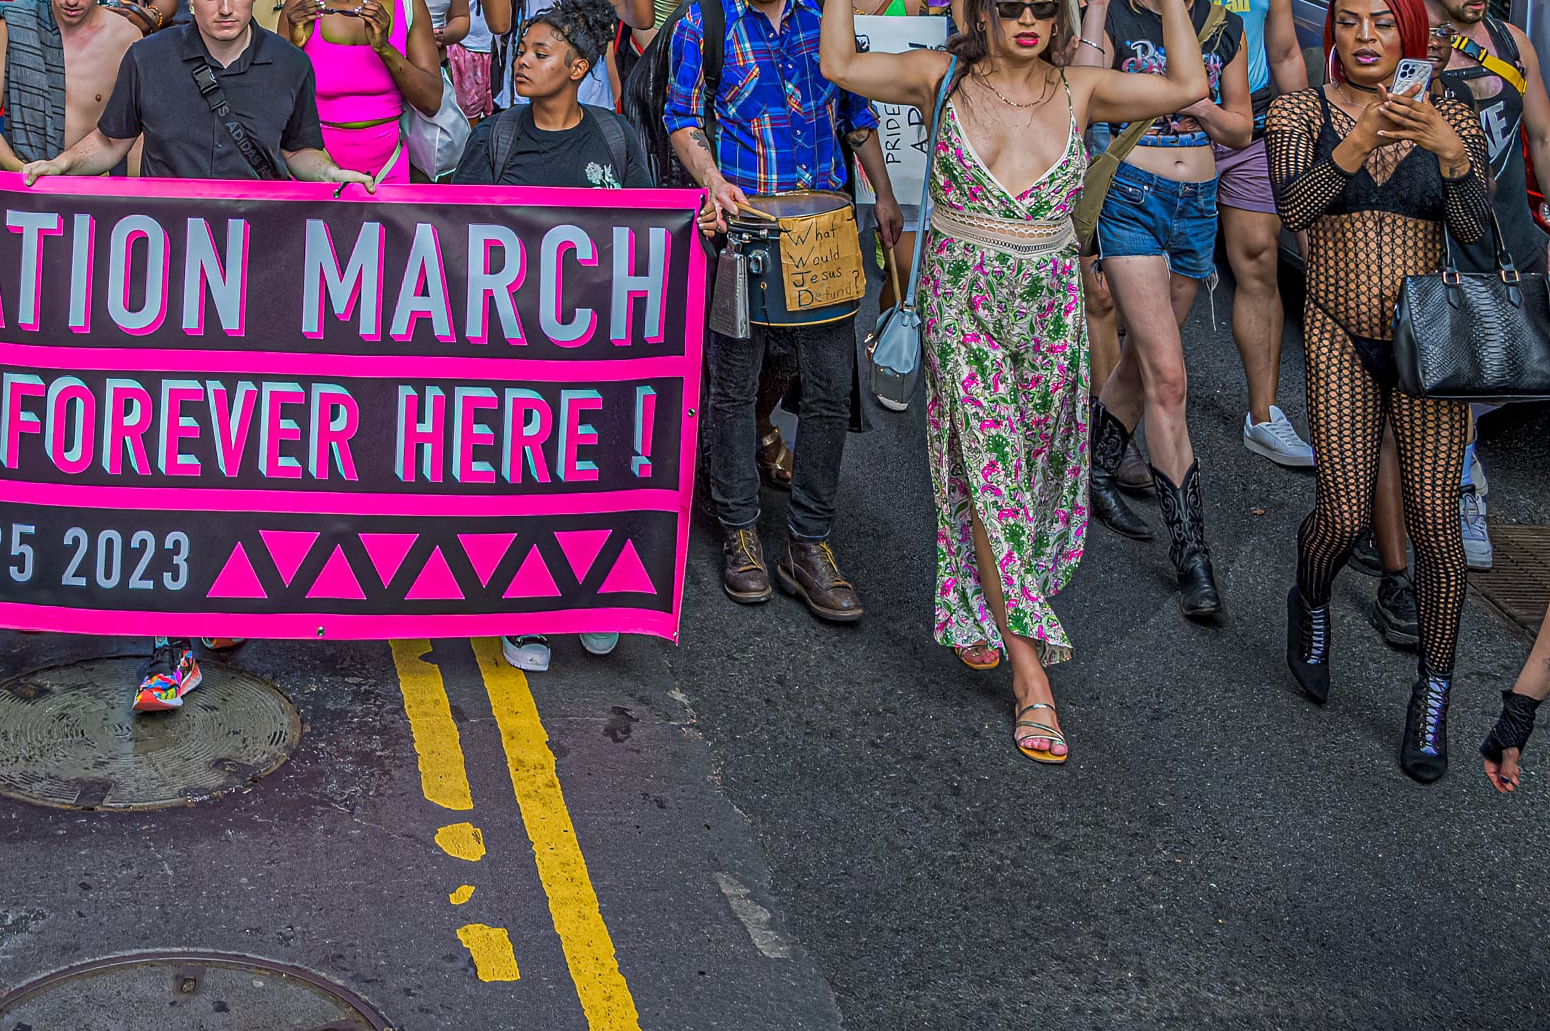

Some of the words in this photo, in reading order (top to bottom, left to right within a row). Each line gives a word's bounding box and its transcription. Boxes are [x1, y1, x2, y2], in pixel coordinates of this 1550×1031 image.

[782, 221, 838, 247] What
[787, 246, 841, 269] Would
[791, 268, 842, 288] Jesus
[302, 217, 672, 348] MARCH
[0, 371, 360, 482] FOREVER
[394, 384, 604, 483] HERE
[62, 526, 191, 592] 2023
